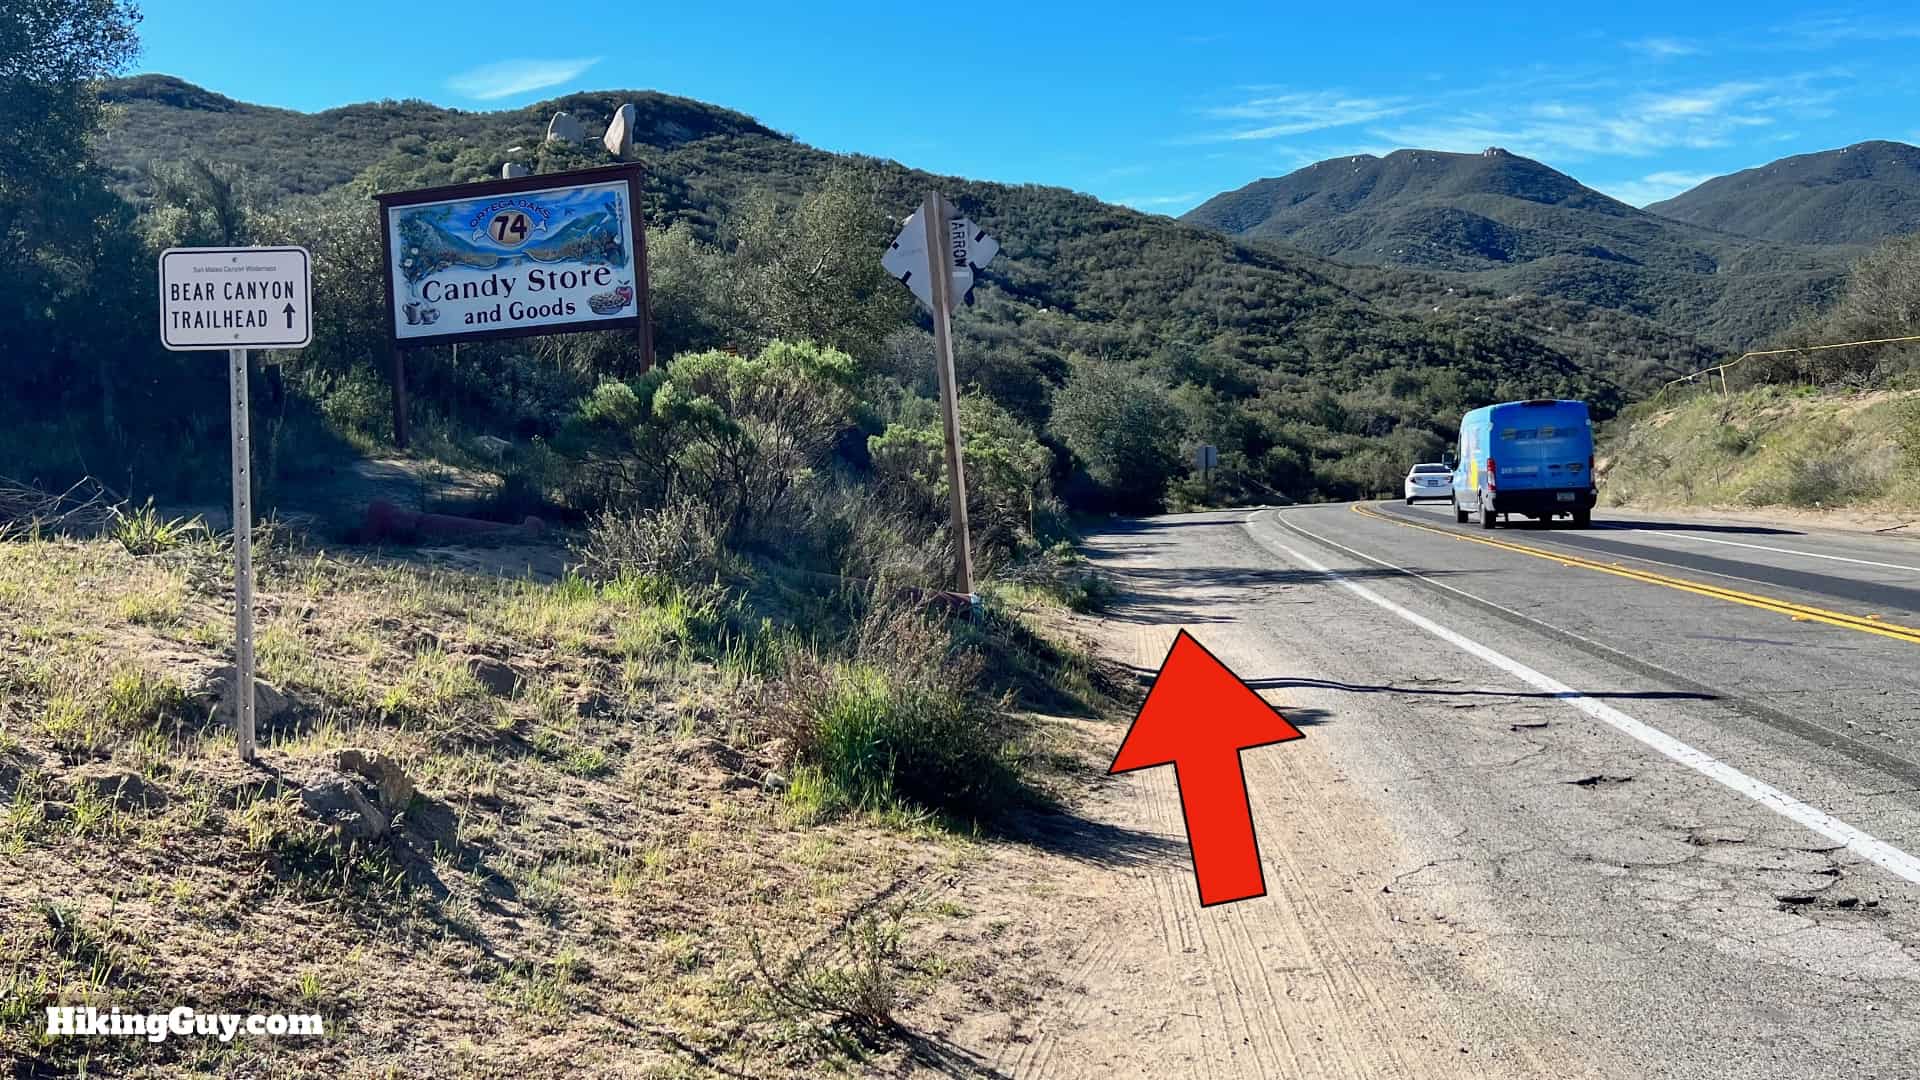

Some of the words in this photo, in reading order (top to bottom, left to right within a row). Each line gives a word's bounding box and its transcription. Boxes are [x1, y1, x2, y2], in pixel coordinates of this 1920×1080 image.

[519, 200, 551, 219] OAKS
[494, 214, 527, 240] 74
[171, 282, 215, 301] BEAR
[224, 281, 294, 300] CANYON
[422, 273, 516, 303] Candy
[528, 266, 612, 292] Store
[172, 309, 268, 328] TRAILHEAD
[464, 304, 501, 324] and
[509, 297, 576, 321] Goods
